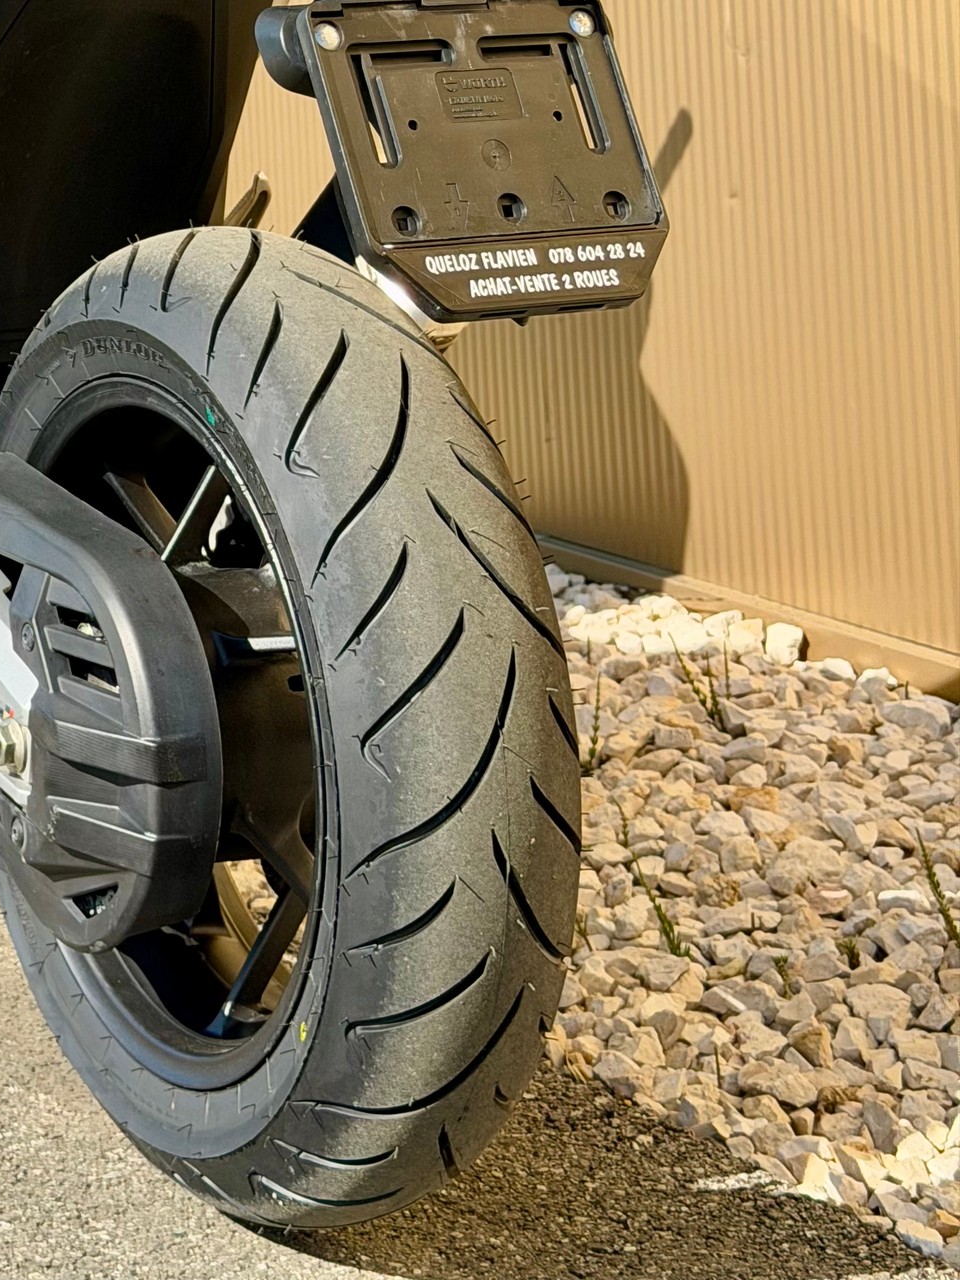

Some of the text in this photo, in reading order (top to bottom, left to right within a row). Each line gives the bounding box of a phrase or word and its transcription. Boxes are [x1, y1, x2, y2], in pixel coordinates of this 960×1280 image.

[425, 242, 645, 274] QUELOZ FLAVIEN 078 604 28 24
[469, 269, 620, 299] ACHAT-VENTE 2 ROUES
